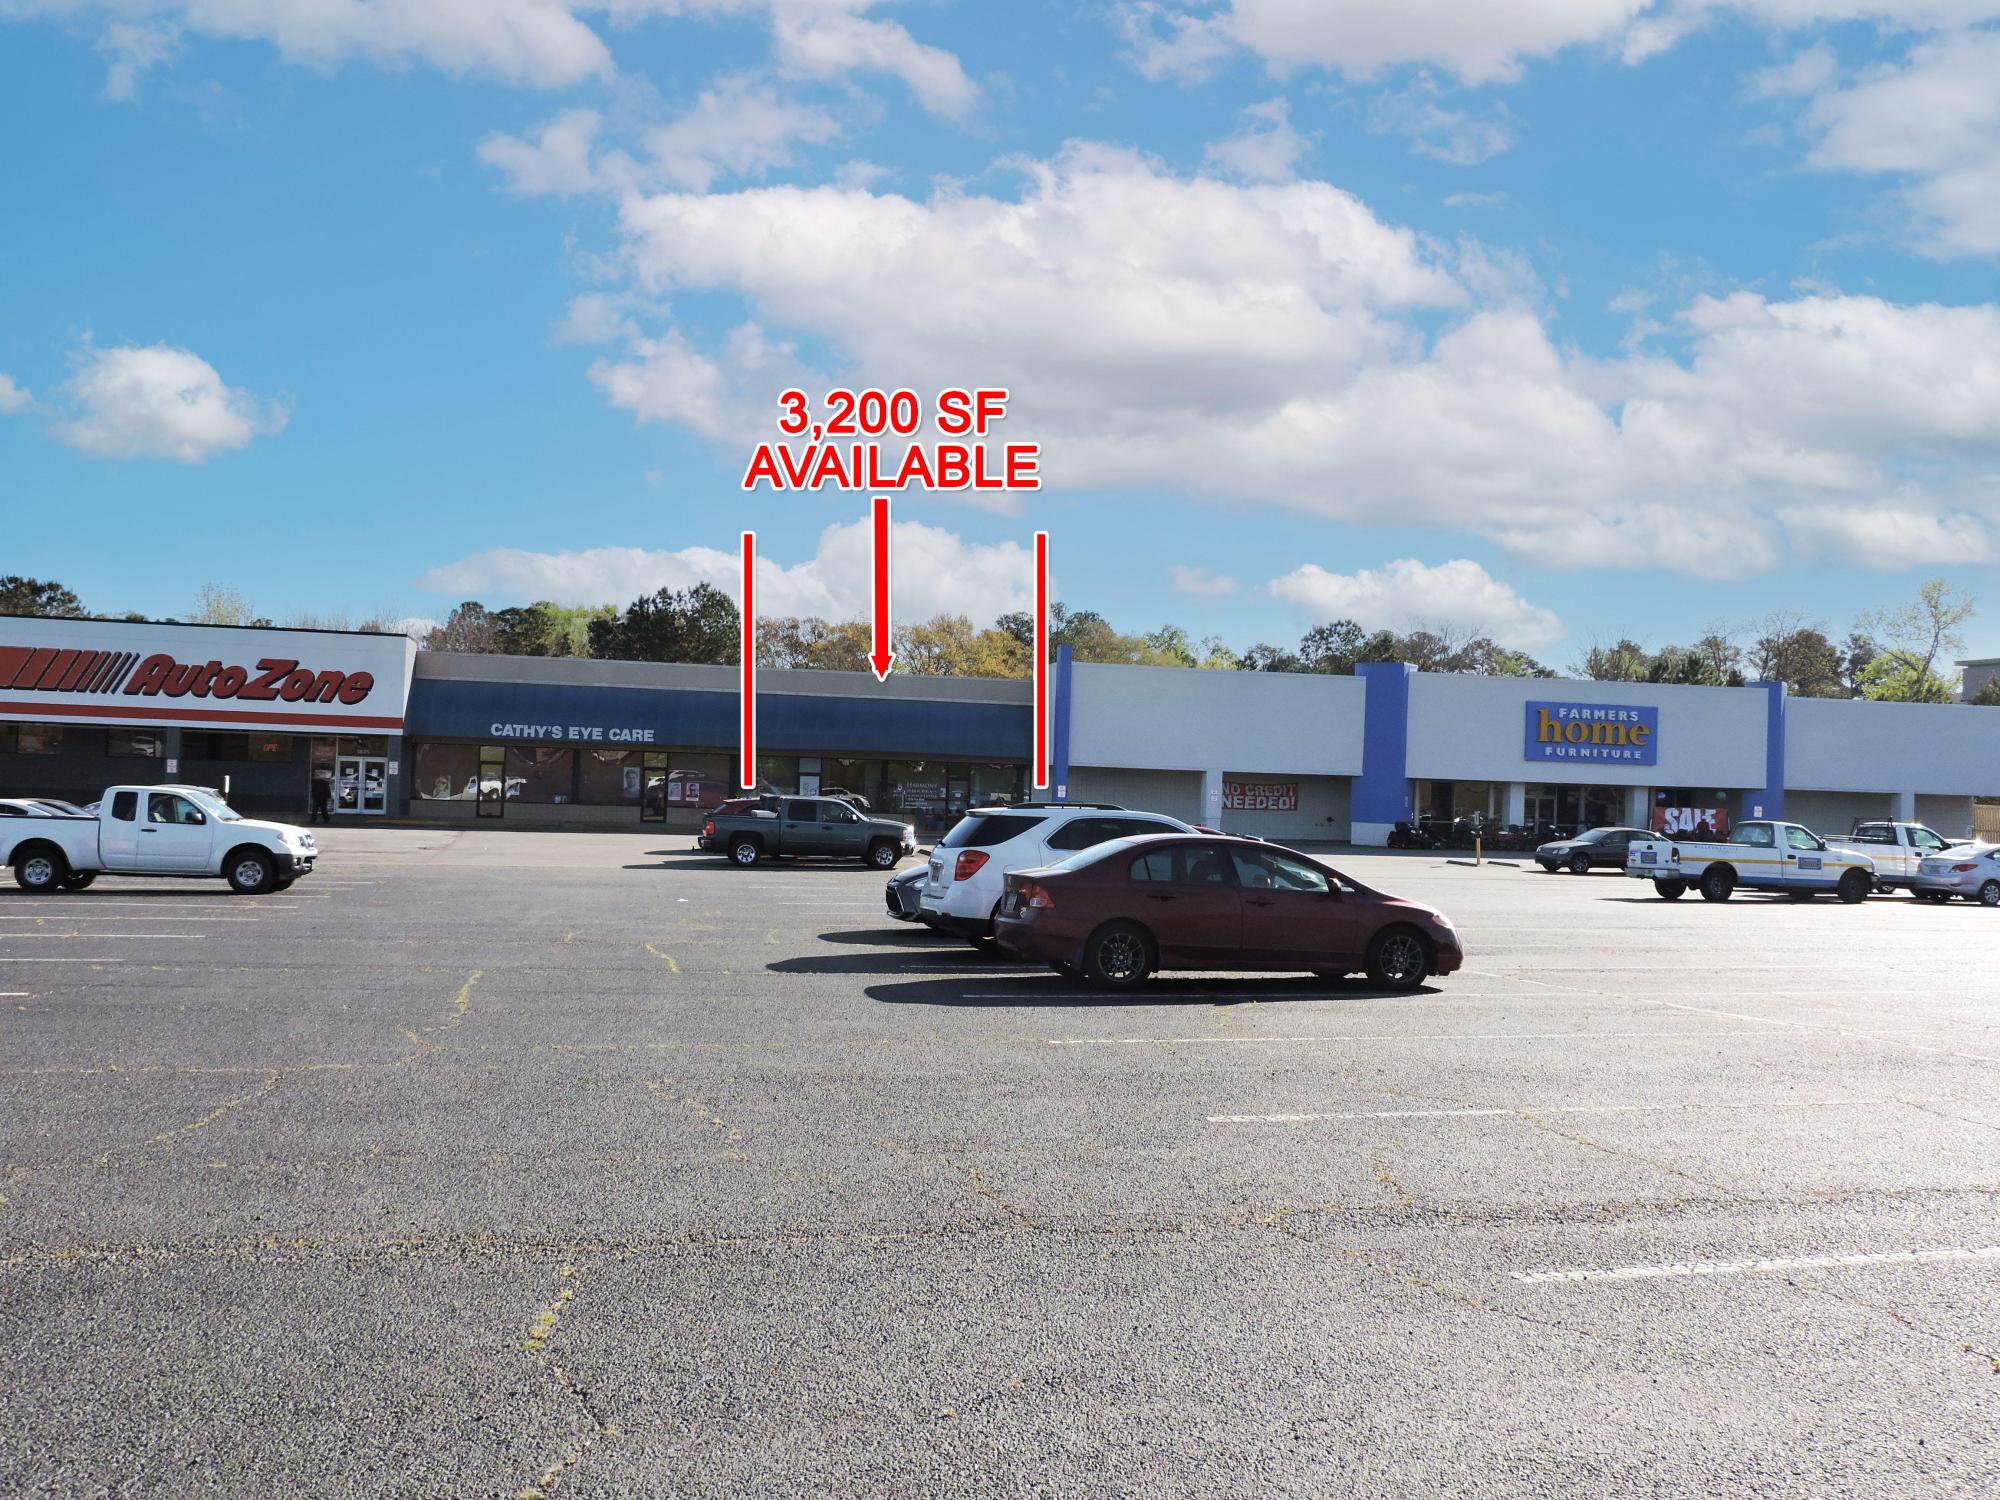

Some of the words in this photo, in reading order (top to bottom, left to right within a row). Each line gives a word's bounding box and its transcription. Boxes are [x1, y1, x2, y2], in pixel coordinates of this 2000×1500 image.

[123, 653, 375, 706] AutoZone
[1558, 708, 1639, 722] FARMERS
[490, 723, 563, 739] CATHY'S
[568, 726, 603, 740] EYE
[608, 728, 655, 742] CARE
[1537, 707, 1651, 746] home
[1545, 747, 1641, 759] FURNITURE
[1222, 782, 1241, 795] NO
[1245, 784, 1296, 797] CREDIT
[1222, 795, 1296, 810] NEEDED!
